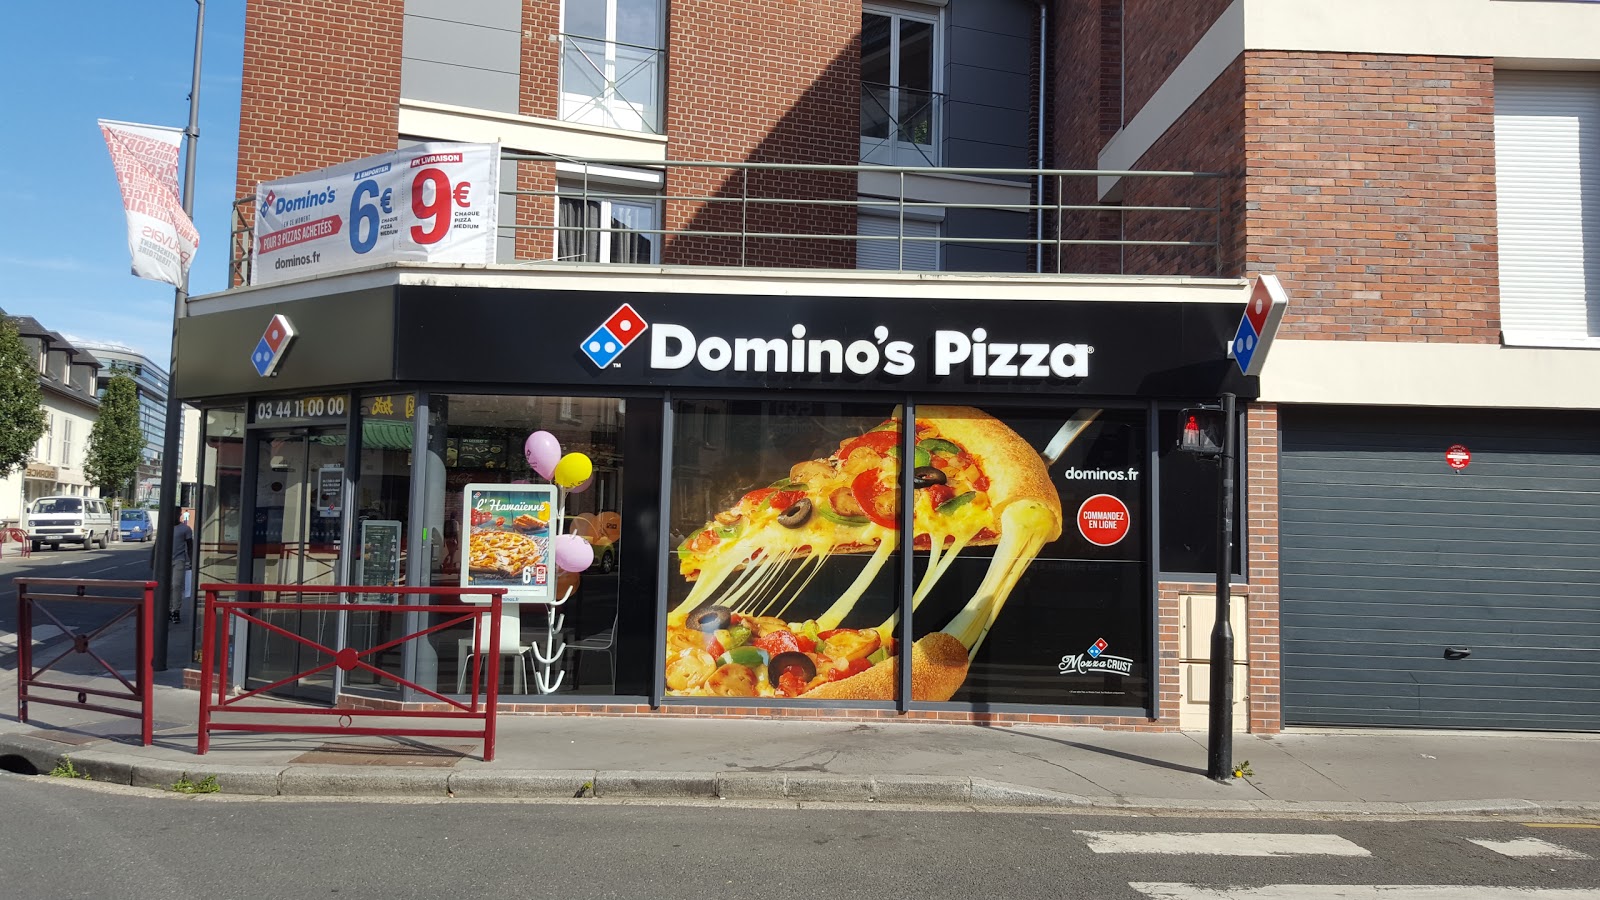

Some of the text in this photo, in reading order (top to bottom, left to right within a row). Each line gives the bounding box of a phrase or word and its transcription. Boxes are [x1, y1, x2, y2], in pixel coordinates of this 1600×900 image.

[421, 155, 460, 165] LIVRAISON
[361, 165, 389, 178] EMPORTER
[276, 185, 336, 215] Domino's
[295, 215, 311, 225] MOMENT
[381, 216, 398, 224] CHAQUE
[263, 236, 277, 251] POUR
[277, 235, 282, 246] 3
[282, 230, 301, 246] PIZZAS
[275, 251, 321, 270] dominos.fr
[650, 323, 916, 376] Domino's
[258, 397, 344, 419] 03 44 11 00 00
[1065, 466, 1139, 481] dominos.fr
[1083, 511, 1124, 520] COMMANDEZ
[1088, 520, 1117, 529] EN LIGNE
[1058, 653, 1133, 675] Mozza CRUST
